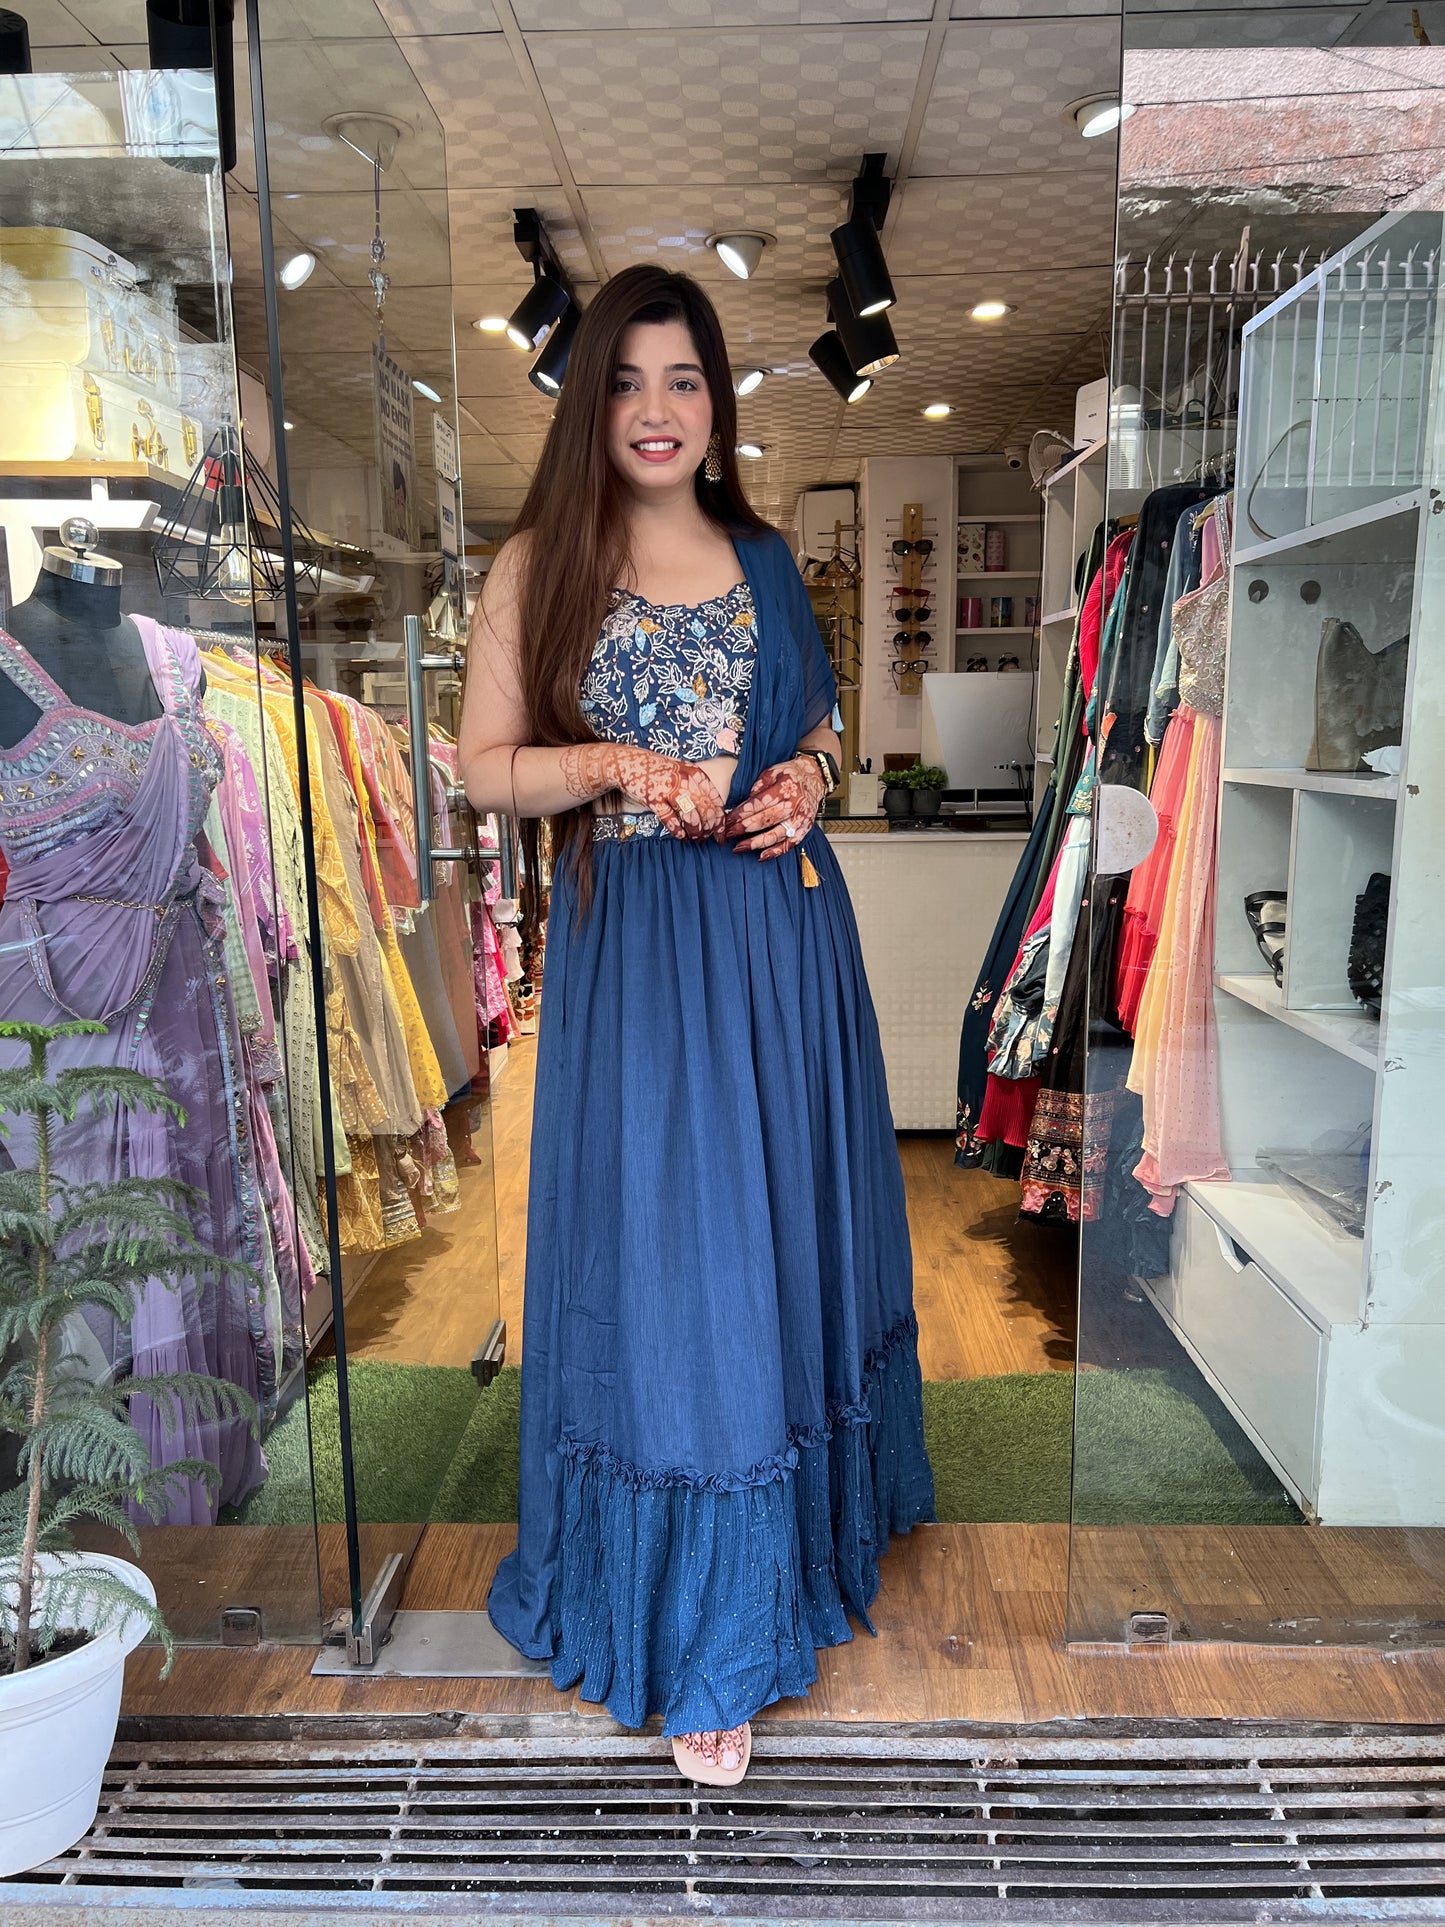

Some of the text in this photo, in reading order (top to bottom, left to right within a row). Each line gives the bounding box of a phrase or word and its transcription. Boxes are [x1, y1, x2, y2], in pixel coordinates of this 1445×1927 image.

[379, 369, 410, 412] NO MASK
[380, 394, 411, 434] NO ENTRY
